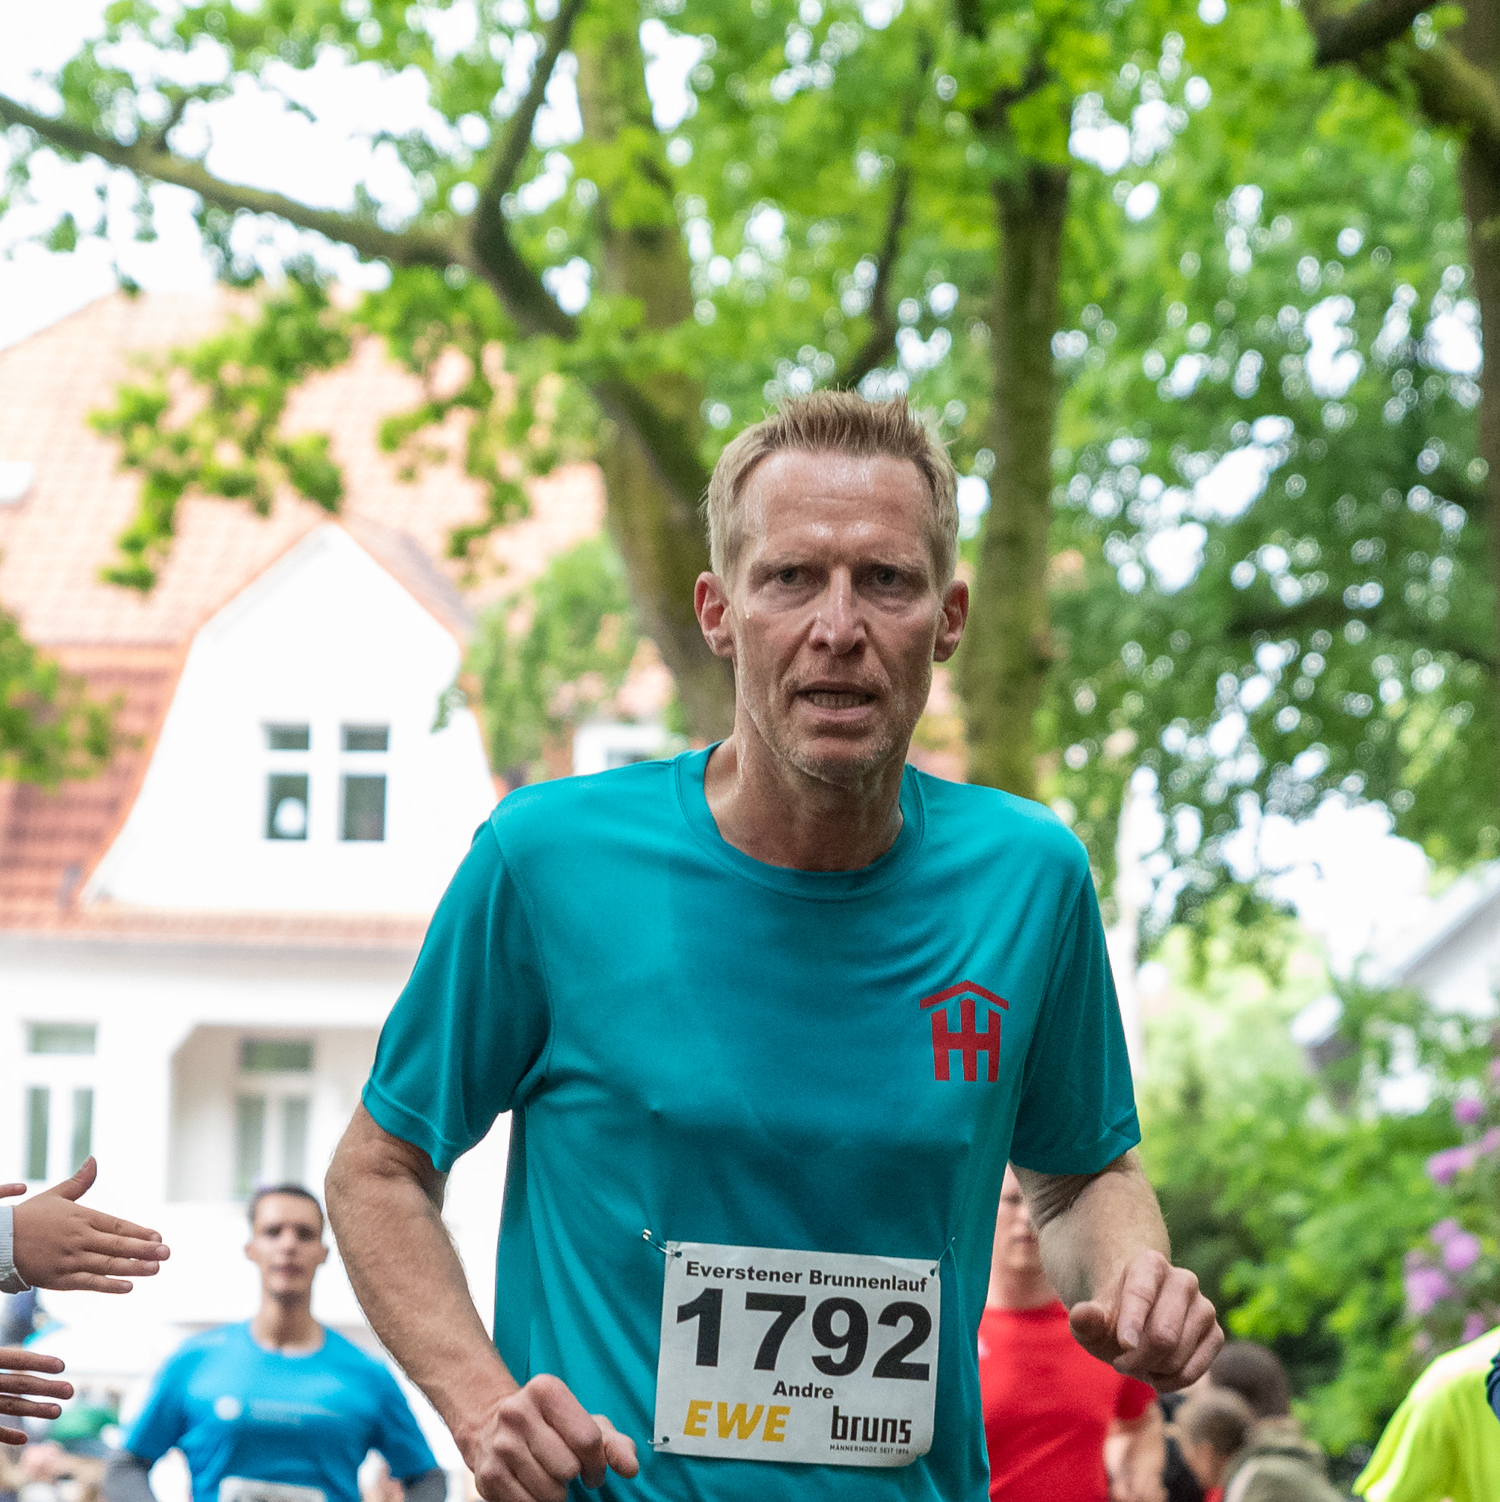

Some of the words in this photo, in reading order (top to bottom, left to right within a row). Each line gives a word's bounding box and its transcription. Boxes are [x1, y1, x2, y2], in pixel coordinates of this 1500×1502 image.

[685, 1260, 803, 1285] Everstener
[808, 1269, 927, 1293] Brunnenlauf
[676, 1287, 932, 1382] 1792
[772, 1380, 834, 1400] Andre
[682, 1399, 791, 1443] EWE
[830, 1405, 913, 1445] bruns
